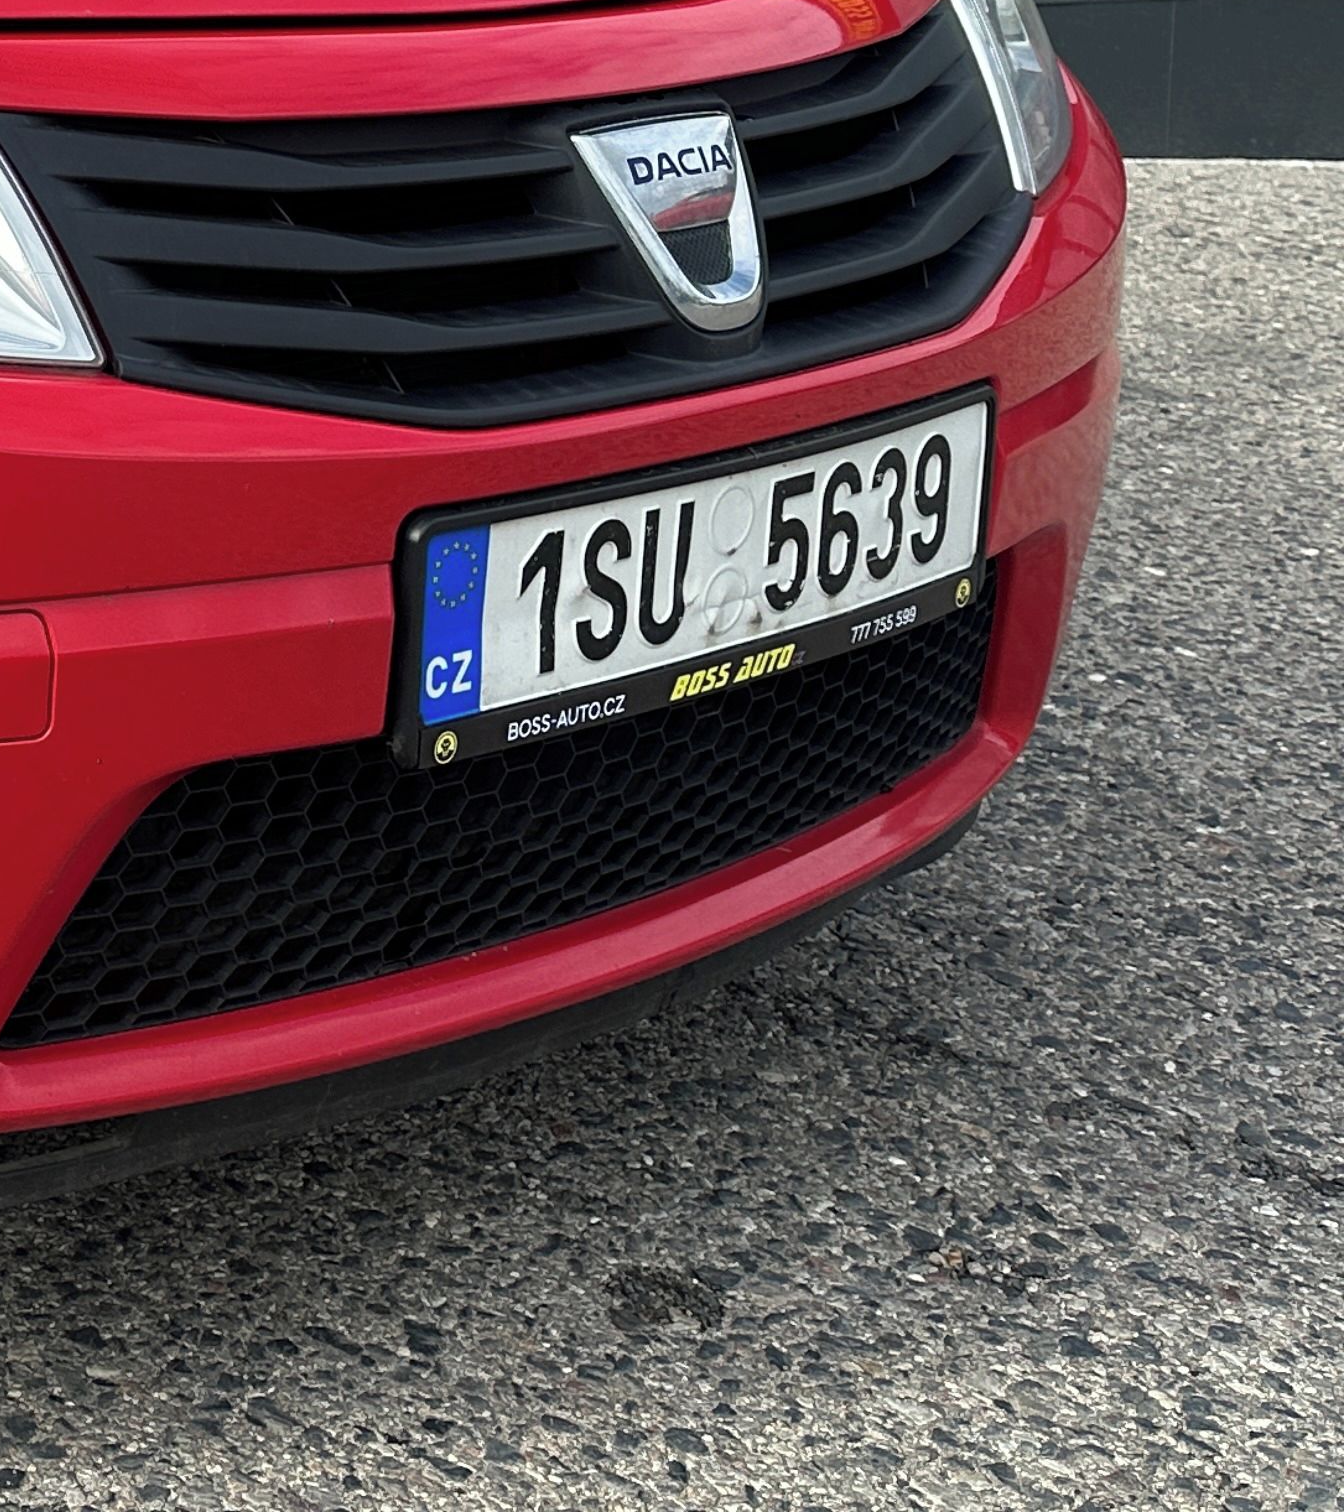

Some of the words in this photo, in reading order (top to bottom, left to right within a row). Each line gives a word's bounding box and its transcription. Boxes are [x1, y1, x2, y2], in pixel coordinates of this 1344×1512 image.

[626, 143, 733, 186] DACIA
[518, 500, 695, 675] 1SU
[764, 433, 952, 613] 5639
[851, 621, 872, 644] 777
[873, 613, 894, 637] 755
[895, 605, 917, 628] 599
[425, 649, 473, 700] CZ
[669, 661, 733, 702] BOSS
[732, 642, 797, 684] AUTO
[507, 694, 627, 742] BOSS-AUTO.CZ
